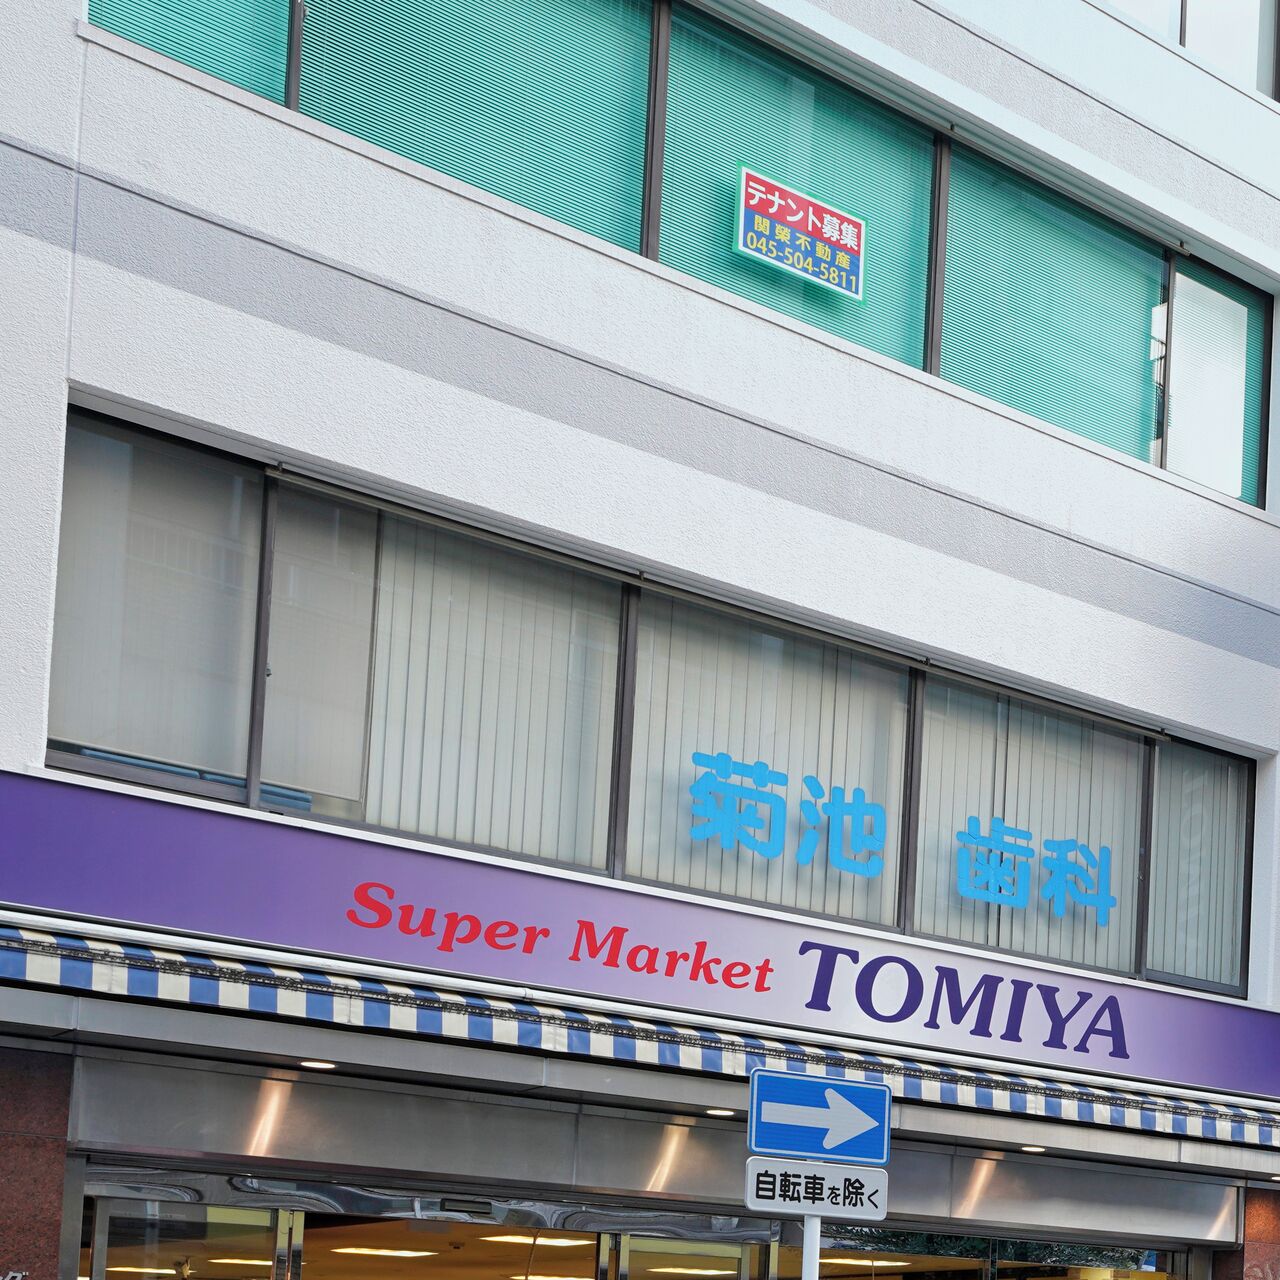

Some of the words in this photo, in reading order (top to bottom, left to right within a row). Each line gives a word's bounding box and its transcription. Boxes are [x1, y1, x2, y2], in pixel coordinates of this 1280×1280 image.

[747, 181, 859, 251] テナント募集
[746, 231, 857, 292] 045-504-5811
[690, 751, 888, 880] 菊池
[955, 816, 1118, 928] 歯科
[346, 881, 551, 956] Super
[569, 919, 776, 994] Market
[798, 940, 1132, 1061] TOMIYA
[755, 1169, 879, 1209] 自転車を除く
